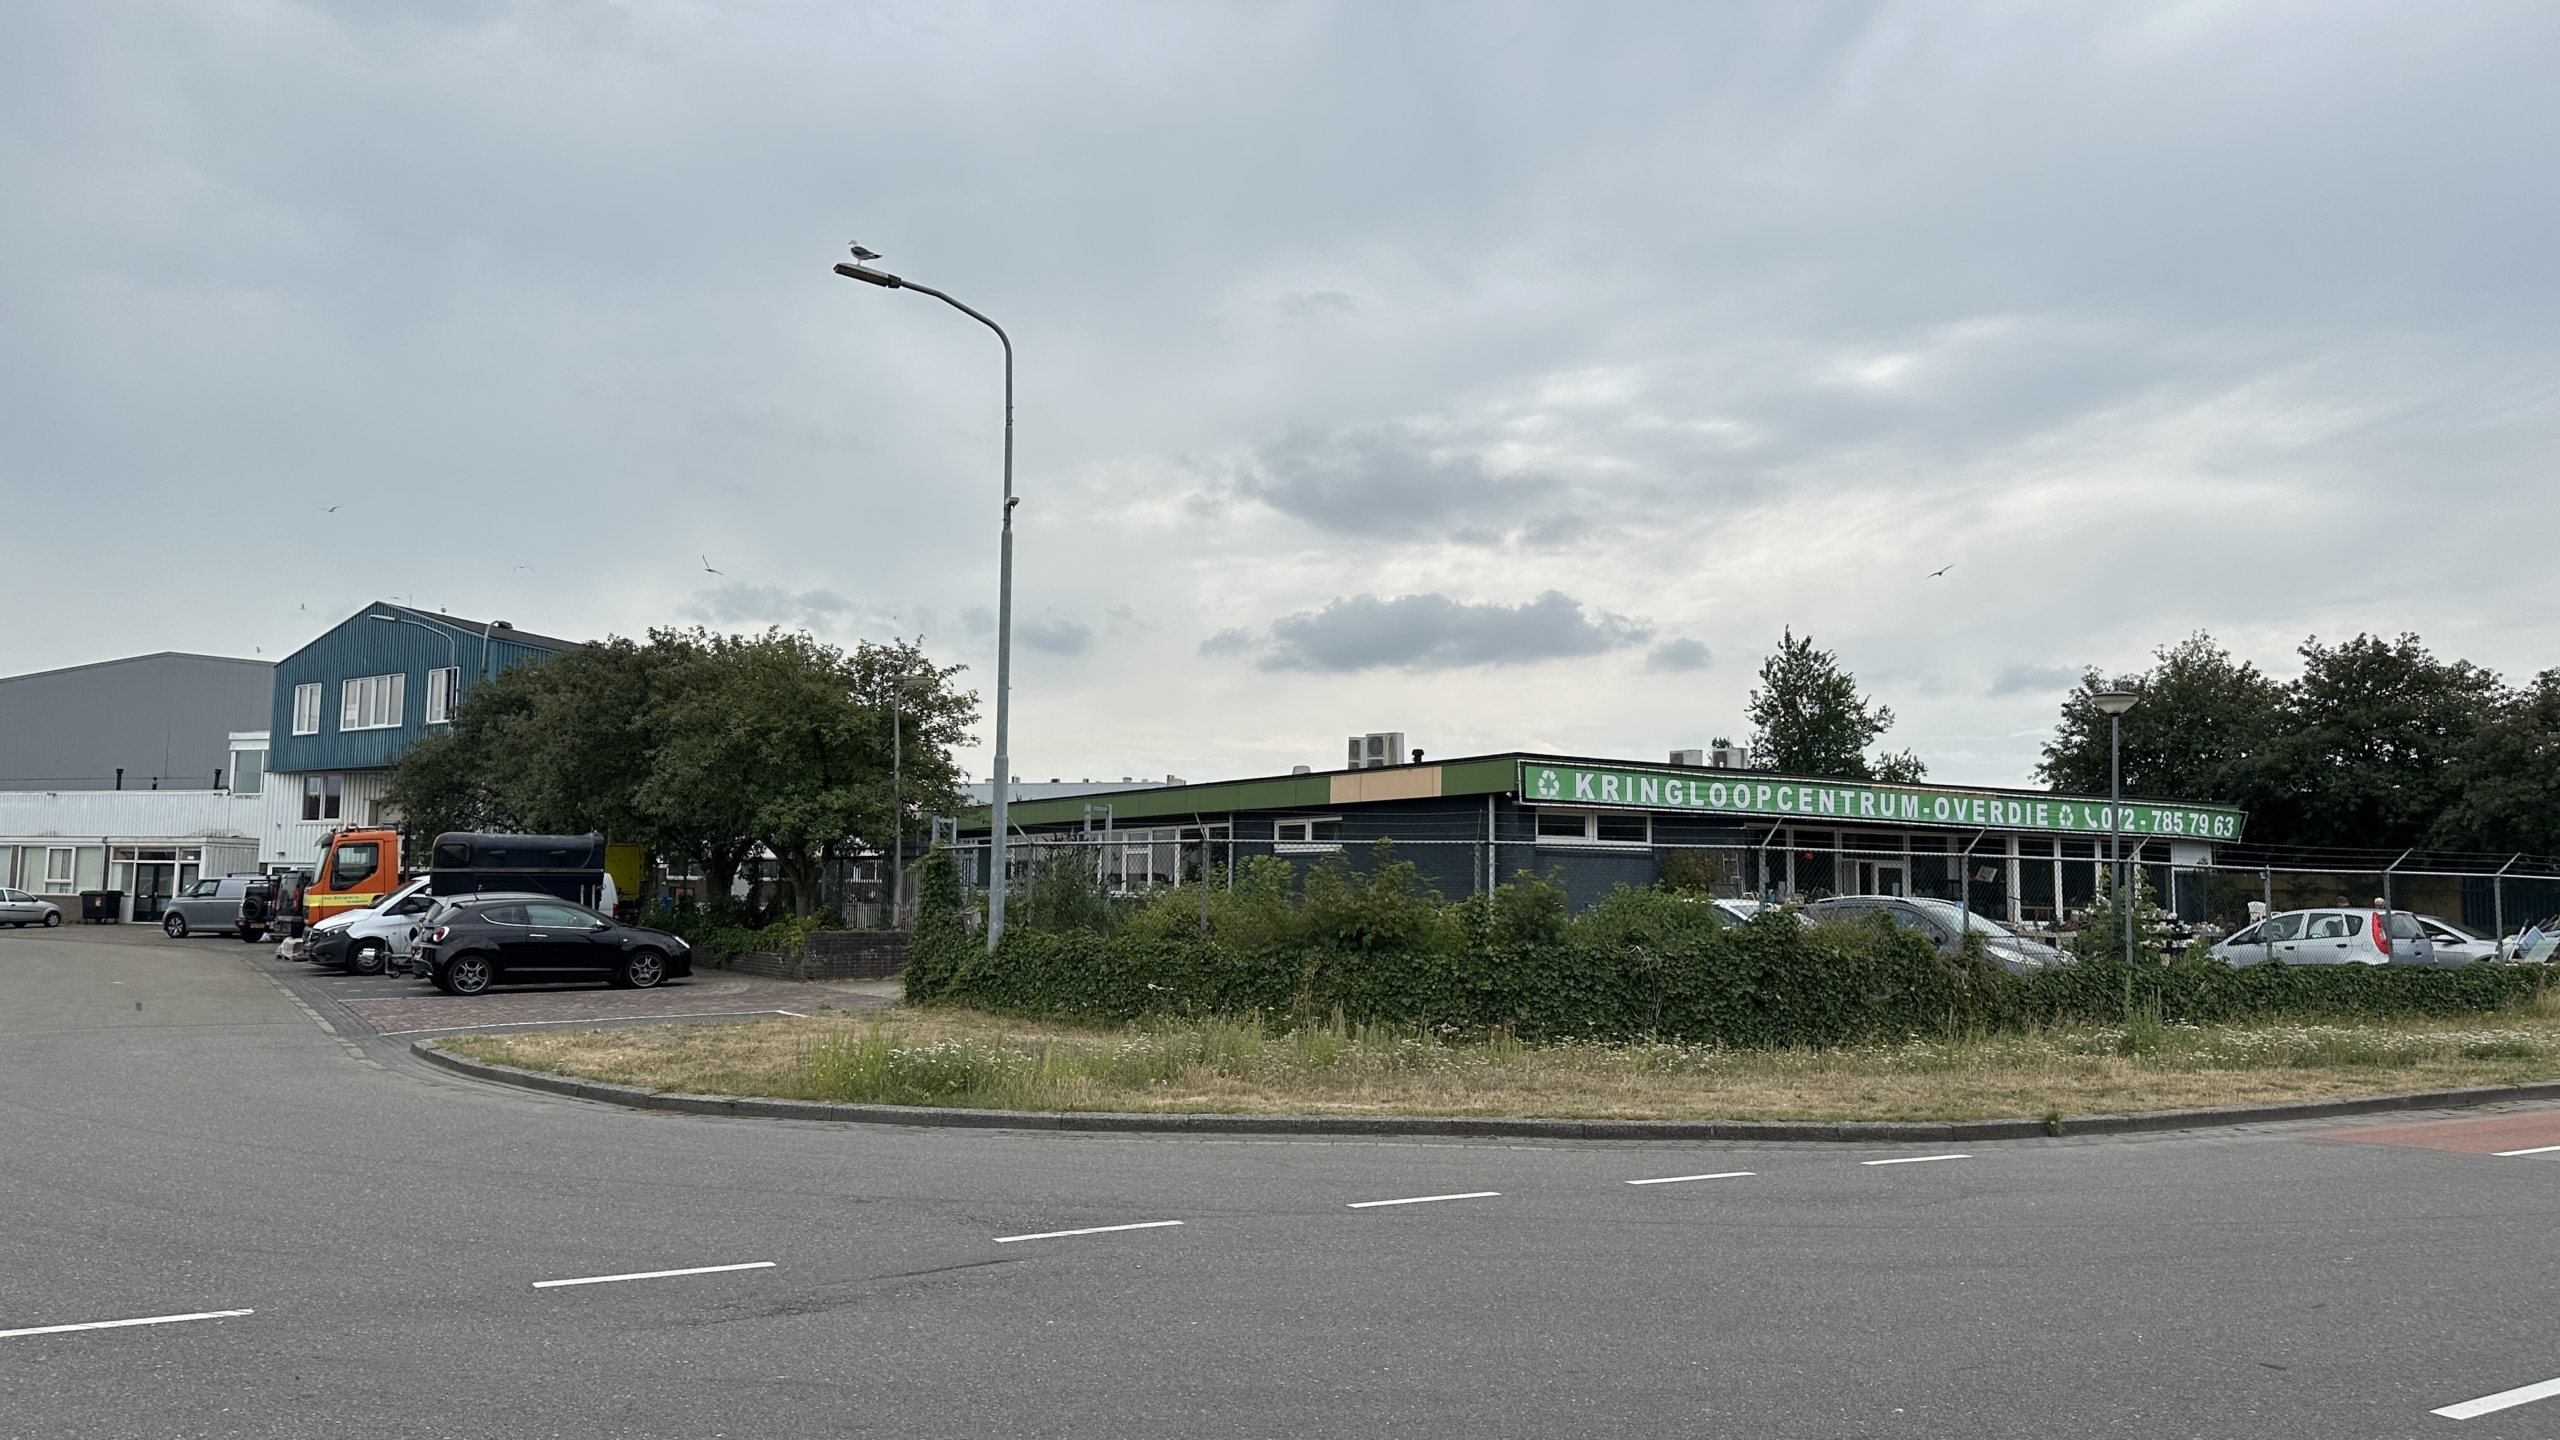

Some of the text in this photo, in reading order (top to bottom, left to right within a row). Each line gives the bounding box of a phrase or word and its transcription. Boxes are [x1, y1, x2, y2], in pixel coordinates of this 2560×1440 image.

[2151, 810, 2183, 833] 785
[2188, 812, 2209, 834] 79
[2214, 815, 2234, 837] 63
